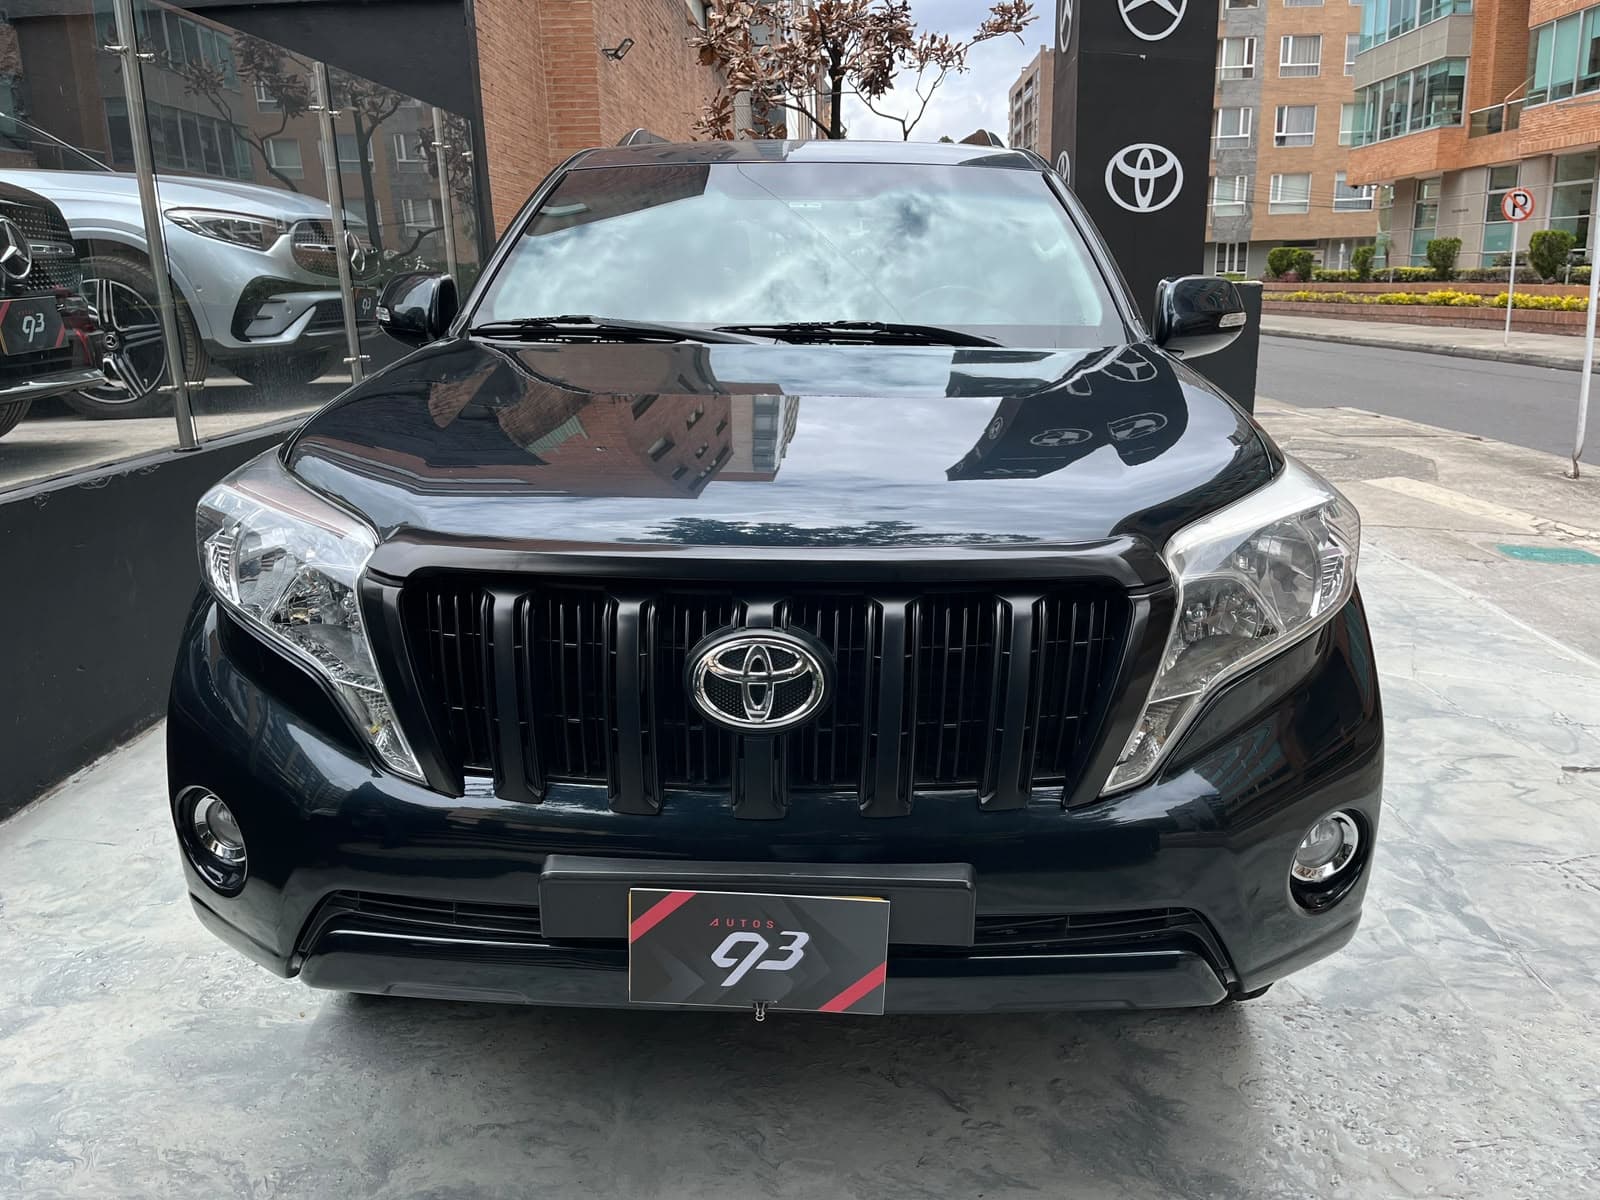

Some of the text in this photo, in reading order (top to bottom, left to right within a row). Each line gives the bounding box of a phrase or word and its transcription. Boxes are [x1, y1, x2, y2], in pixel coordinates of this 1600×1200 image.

[1512, 193, 1528, 217] P
[22, 312, 45, 343] 93
[709, 917, 776, 929] AUTOS
[710, 930, 810, 987] 93
